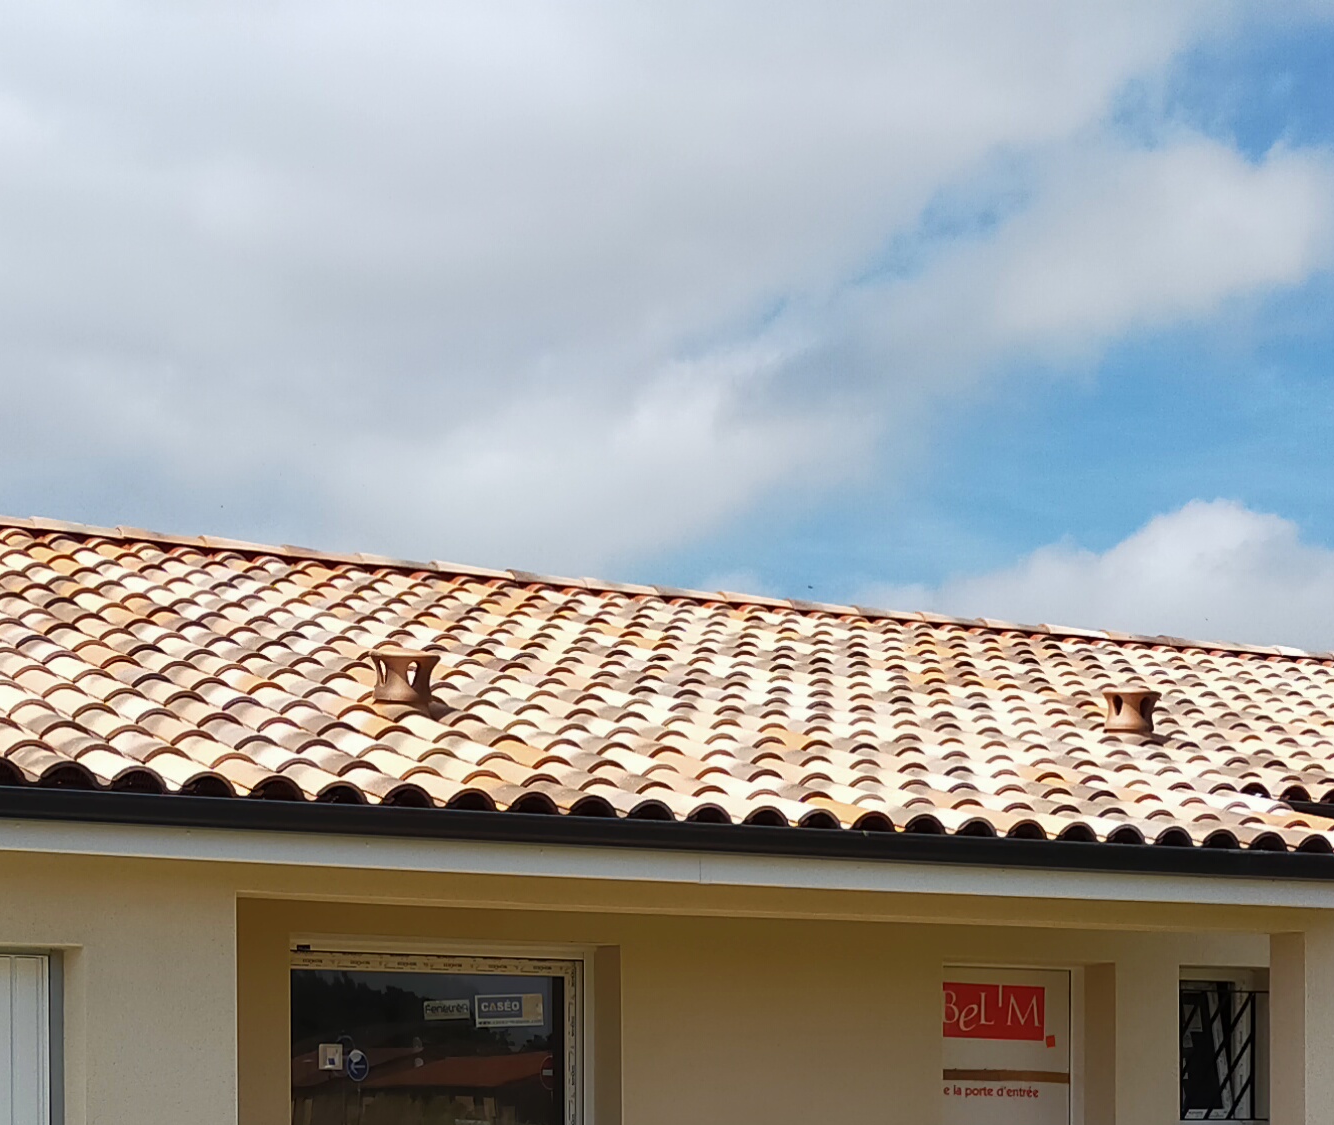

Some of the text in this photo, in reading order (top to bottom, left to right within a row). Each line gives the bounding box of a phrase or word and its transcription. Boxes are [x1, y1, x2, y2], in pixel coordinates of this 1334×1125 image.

[953, 1085, 962, 1096] la
[965, 1086, 993, 1098] porte
[996, 1086, 1039, 1098] d'entrée
